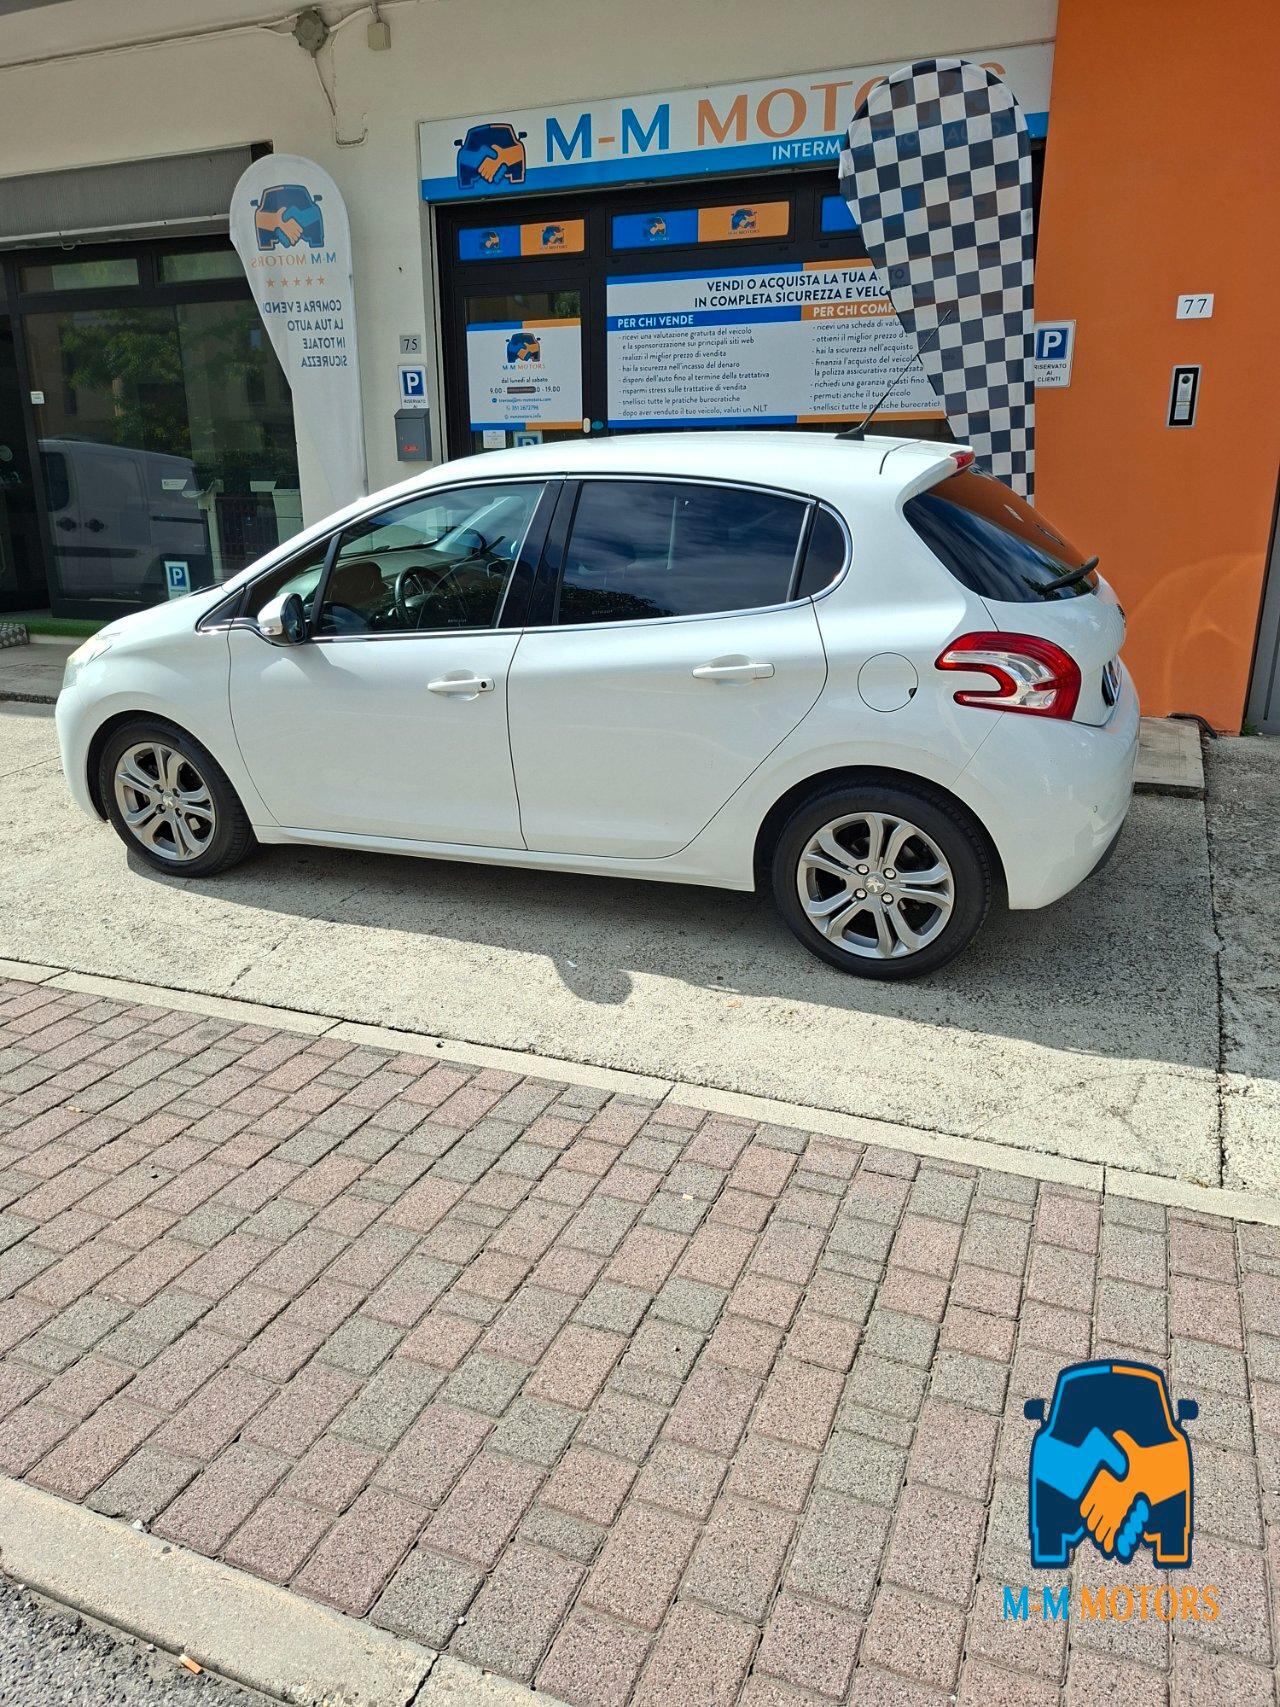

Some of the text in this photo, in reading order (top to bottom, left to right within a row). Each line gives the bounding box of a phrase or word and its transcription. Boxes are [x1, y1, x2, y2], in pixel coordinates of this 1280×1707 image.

[546, 104, 669, 162] M-M
[773, 142, 841, 160] INTERM
[707, 280, 744, 292] VENDI
[747, 279, 757, 289] O
[759, 274, 820, 289] ACQUISTA
[823, 273, 839, 284] LA
[842, 271, 866, 283] TUA
[695, 297, 707, 307] IN
[710, 293, 773, 307] COMPLETA
[776, 289, 842, 303] SICUREZZA
[845, 287, 853, 298] E
[813, 306, 834, 317] PER
[836, 305, 857, 316] CHI
[1183, 298, 1208, 314] 77
[617, 315, 694, 328] PER CHI VENDE
[653, 331, 689, 339] valutazione
[690, 329, 716, 340] gratuita
[717, 328, 727, 336] del
[729, 327, 752, 336] veicolo
[816, 334, 840, 343] ottieni
[847, 333, 872, 343] miglior
[874, 333, 897, 342] prezzo
[403, 338, 418, 351] 75
[634, 341, 686, 351] sponsorizzazione
[698, 337, 728, 348] principali
[729, 337, 740, 345] siti
[741, 336, 755, 344] web
[815, 346, 826, 354] hai
[828, 346, 834, 354] la
[835, 345, 867, 353] sicurezza
[1042, 331, 1062, 358] P
[649, 352, 672, 362] miglior
[673, 353, 694, 361] prezzo
[702, 350, 727, 358] vendita
[815, 358, 842, 366] finanzia
[878, 356, 890, 364] del
[622, 364, 632, 372] hai
[633, 364, 639, 372] la
[640, 364, 668, 372] sicurezza
[706, 361, 716, 369] del
[814, 368, 820, 376] la
[821, 367, 845, 378] polizza
[846, 366, 887, 375] assicurativa
[674, 373, 687, 381] fino
[688, 373, 694, 381] al
[695, 373, 721, 381] termine
[722, 372, 738, 380] della
[738, 371, 770, 379] trattativa
[814, 379, 840, 387] richiedi
[856, 378, 885, 389] garanzia
[910, 375, 925, 384] fino
[406, 372, 420, 394] P
[622, 387, 648, 396] risparmi
[668, 385, 682, 393] sulle
[683, 384, 714, 392] trattative
[715, 383, 721, 391] di
[722, 383, 747, 391] vendita
[672, 396, 698, 406] pratiche
[699, 394, 741, 403] burocratiche
[813, 391, 842, 402] permuti
[843, 390, 864, 398] anche
[622, 409, 637, 418] dopo
[724, 405, 742, 413] valuti
[753, 404, 769, 413] NLT
[813, 403, 840, 411] snellisci
[172, 568, 183, 585] P
